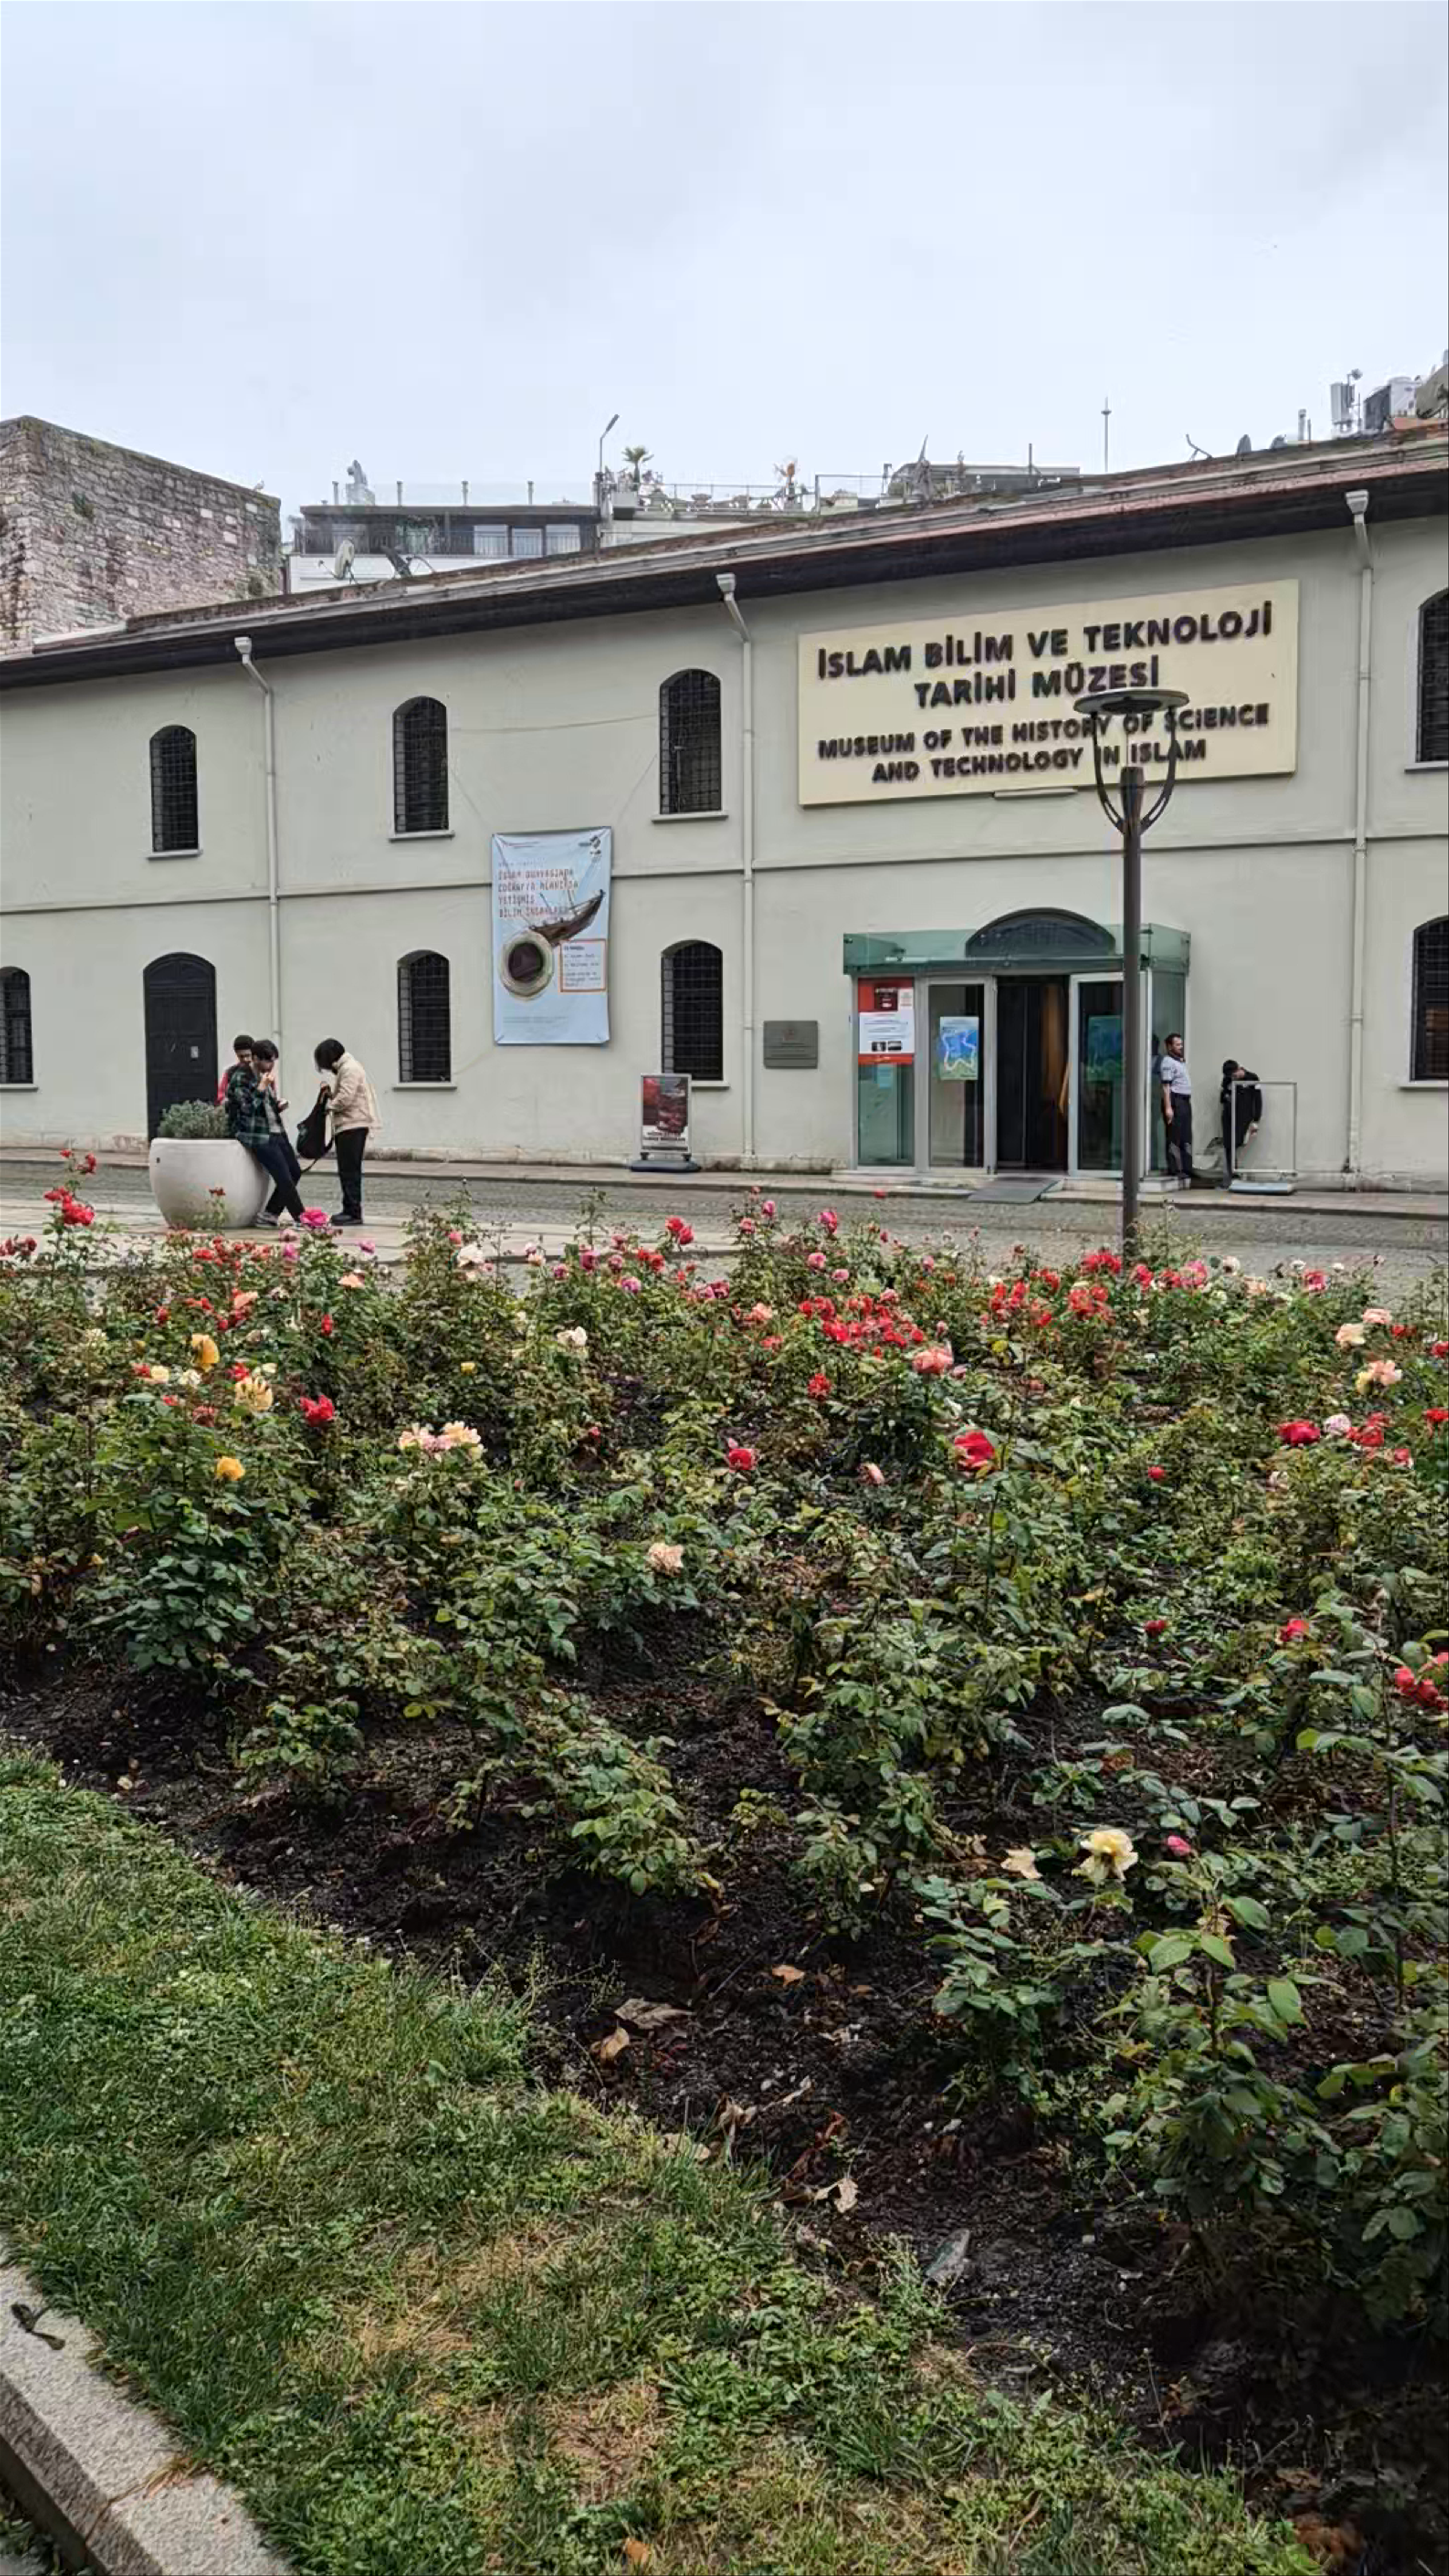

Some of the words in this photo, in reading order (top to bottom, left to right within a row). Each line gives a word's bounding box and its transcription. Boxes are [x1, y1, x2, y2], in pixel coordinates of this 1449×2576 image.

[818, 644, 911, 679] İSLAM
[924, 631, 1013, 669] BİLİM
[1026, 628, 1068, 658] VE
[1083, 600, 1272, 653] TEKNOLOJİ
[914, 668, 1016, 709] TARİHİ
[1032, 654, 1159, 698] MÜZESİ
[818, 732, 915, 760] MUSEUM
[923, 729, 952, 751] OF
[961, 724, 1003, 747] THE
[1012, 715, 1112, 742] HISTORY
[1123, 712, 1154, 734] OF
[1164, 703, 1270, 732] SCIENCE
[872, 761, 920, 783] AND
[929, 747, 1084, 778] TECHNOLOGY
[1094, 744, 1120, 767] IN
[1131, 738, 1206, 763] ISLAM
